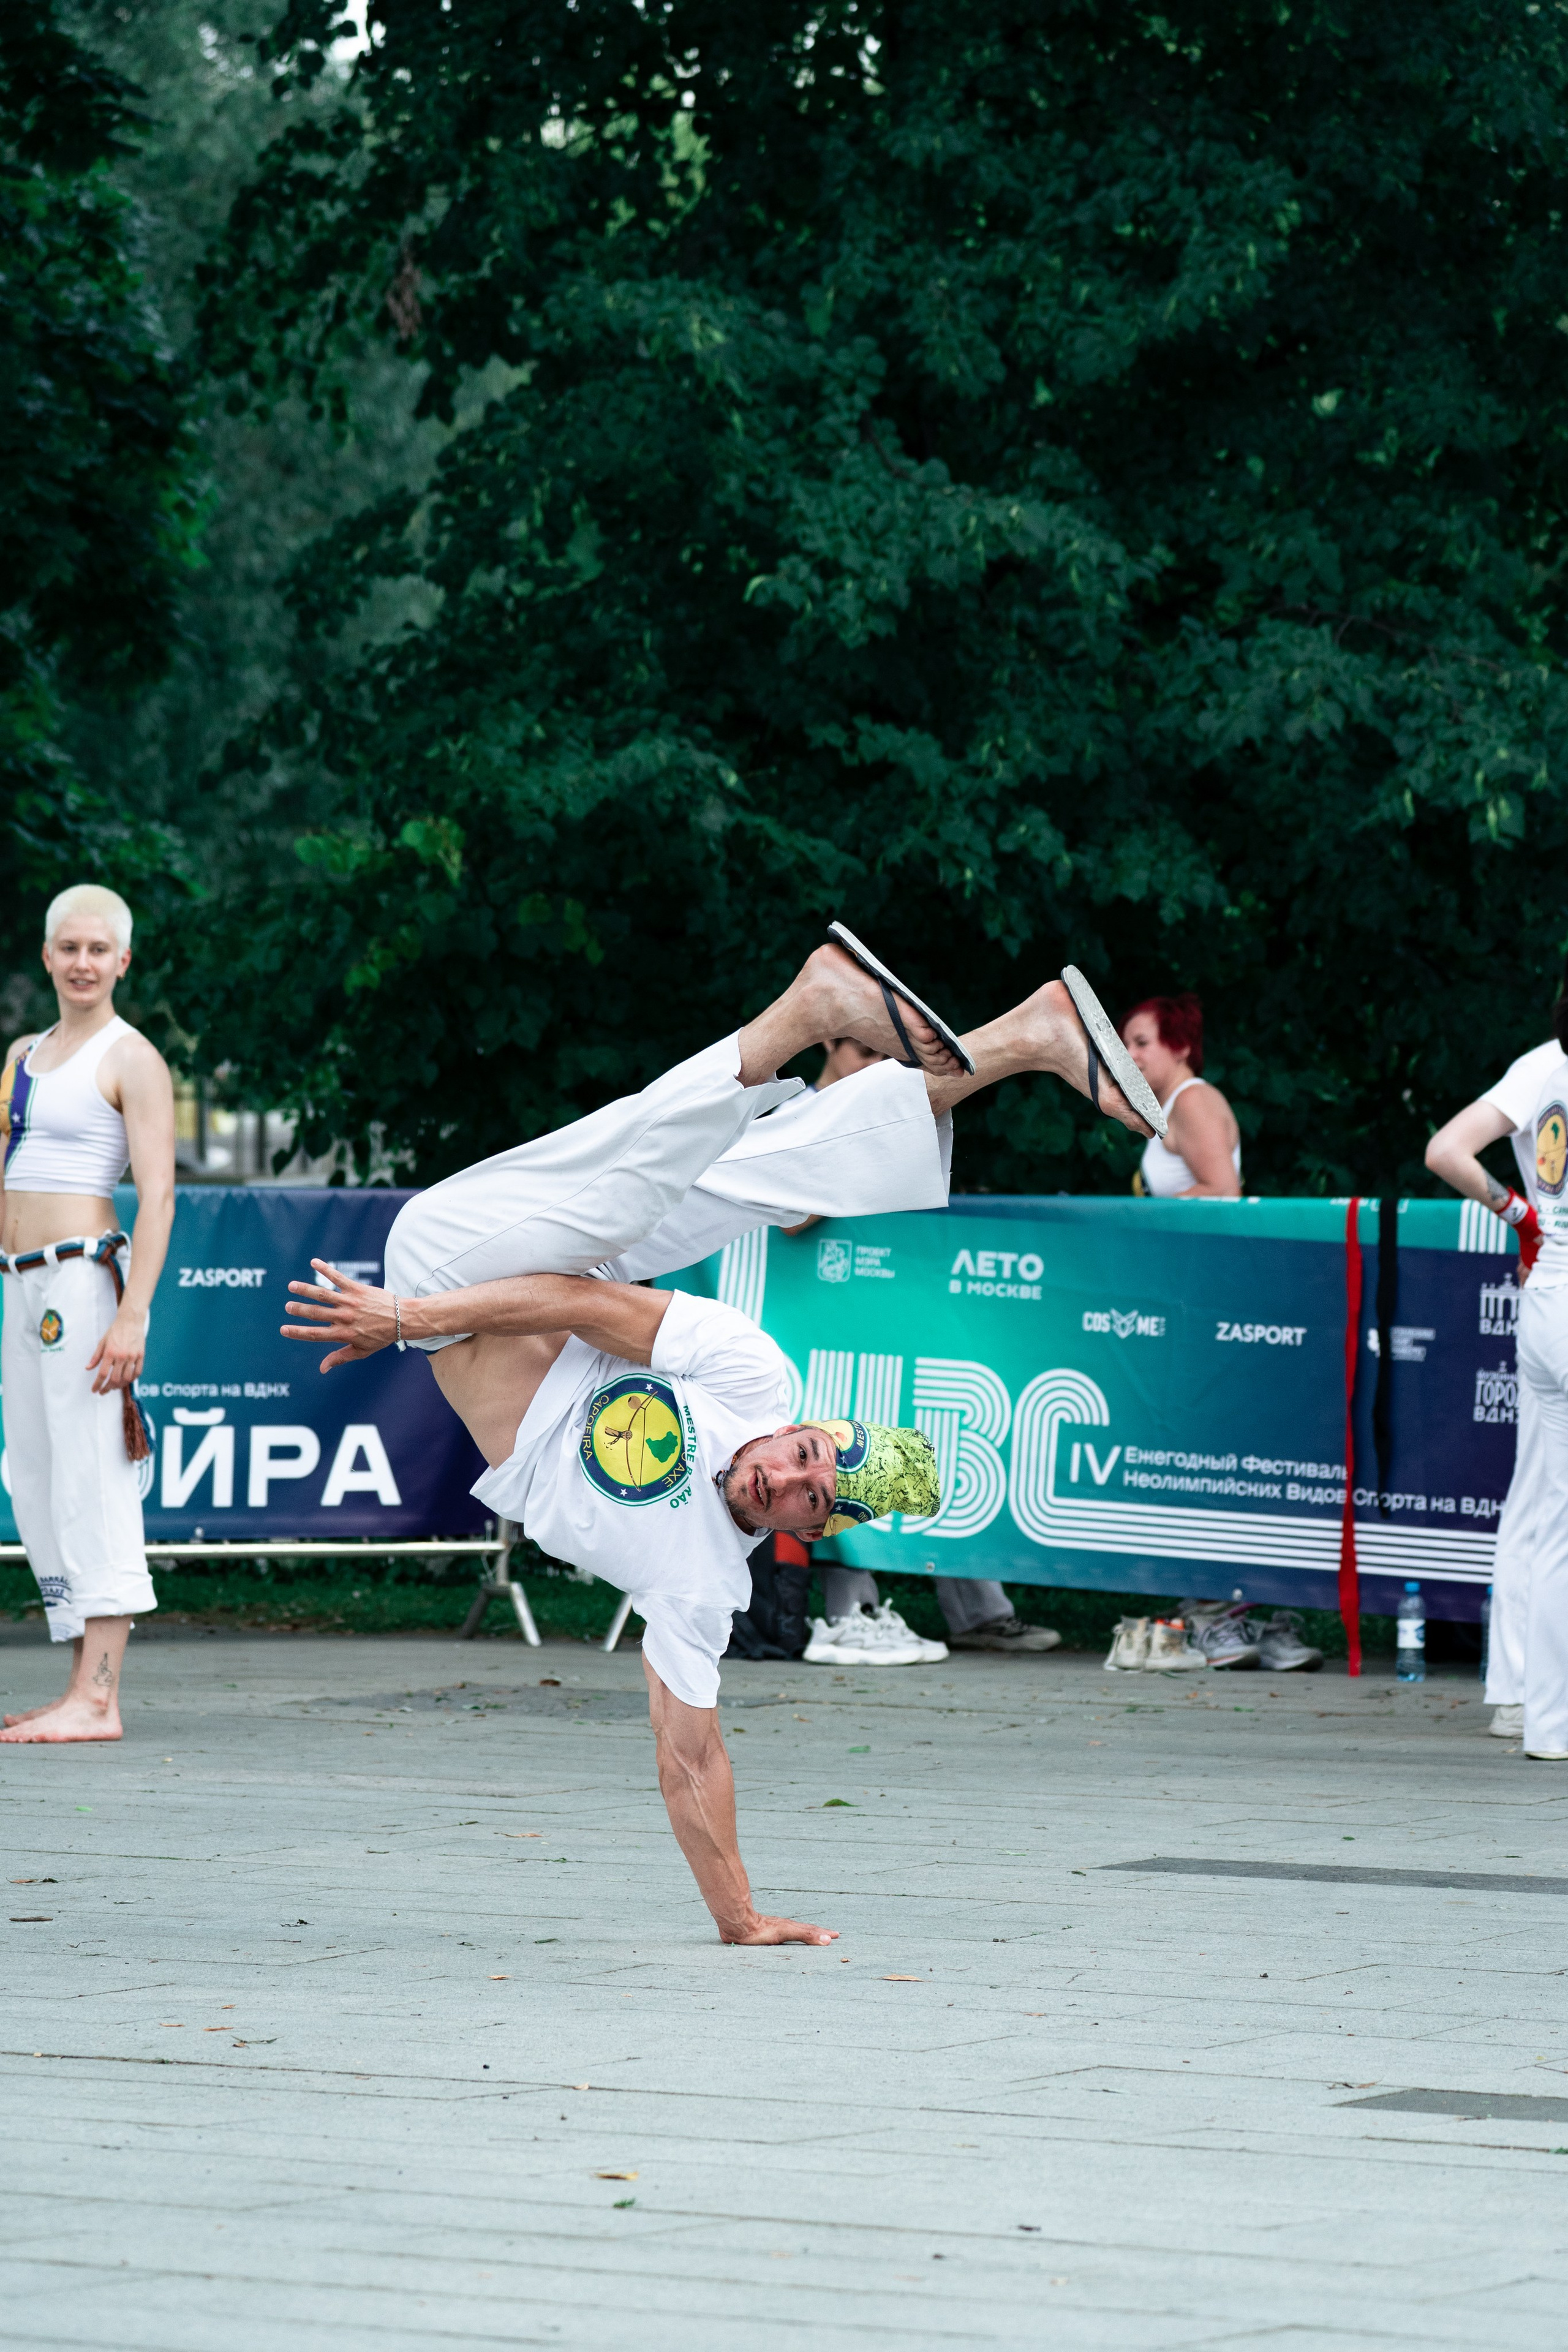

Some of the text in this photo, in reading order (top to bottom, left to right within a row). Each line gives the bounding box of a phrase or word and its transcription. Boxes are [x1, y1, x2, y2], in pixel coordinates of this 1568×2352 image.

[178, 1268, 267, 1287] ZASPORT
[951, 1249, 1044, 1281] ЛЕТО
[949, 1279, 1042, 1300] В МОСКВЕ
[1215, 1321, 1308, 1347] ZASPORT
[162, 1382, 219, 1399] Спорта
[221, 1383, 241, 1398] на
[243, 1382, 290, 1400] ВДНХ
[1475, 1379, 1519, 1408] ГОРО
[582, 1395, 609, 1461] CAPOEIRA
[1473, 1404, 1519, 1424] ВДН
[683, 1405, 697, 1463] MESTRE
[1070, 1442, 1122, 1486] IV
[1125, 1446, 1348, 1481] Ежегодный Фестиваль
[1123, 1469, 1283, 1499] Неолимпийских
[1286, 1482, 1348, 1506] Видов
[1431, 1496, 1457, 1513] на
[1460, 1496, 1505, 1520] ВДН
